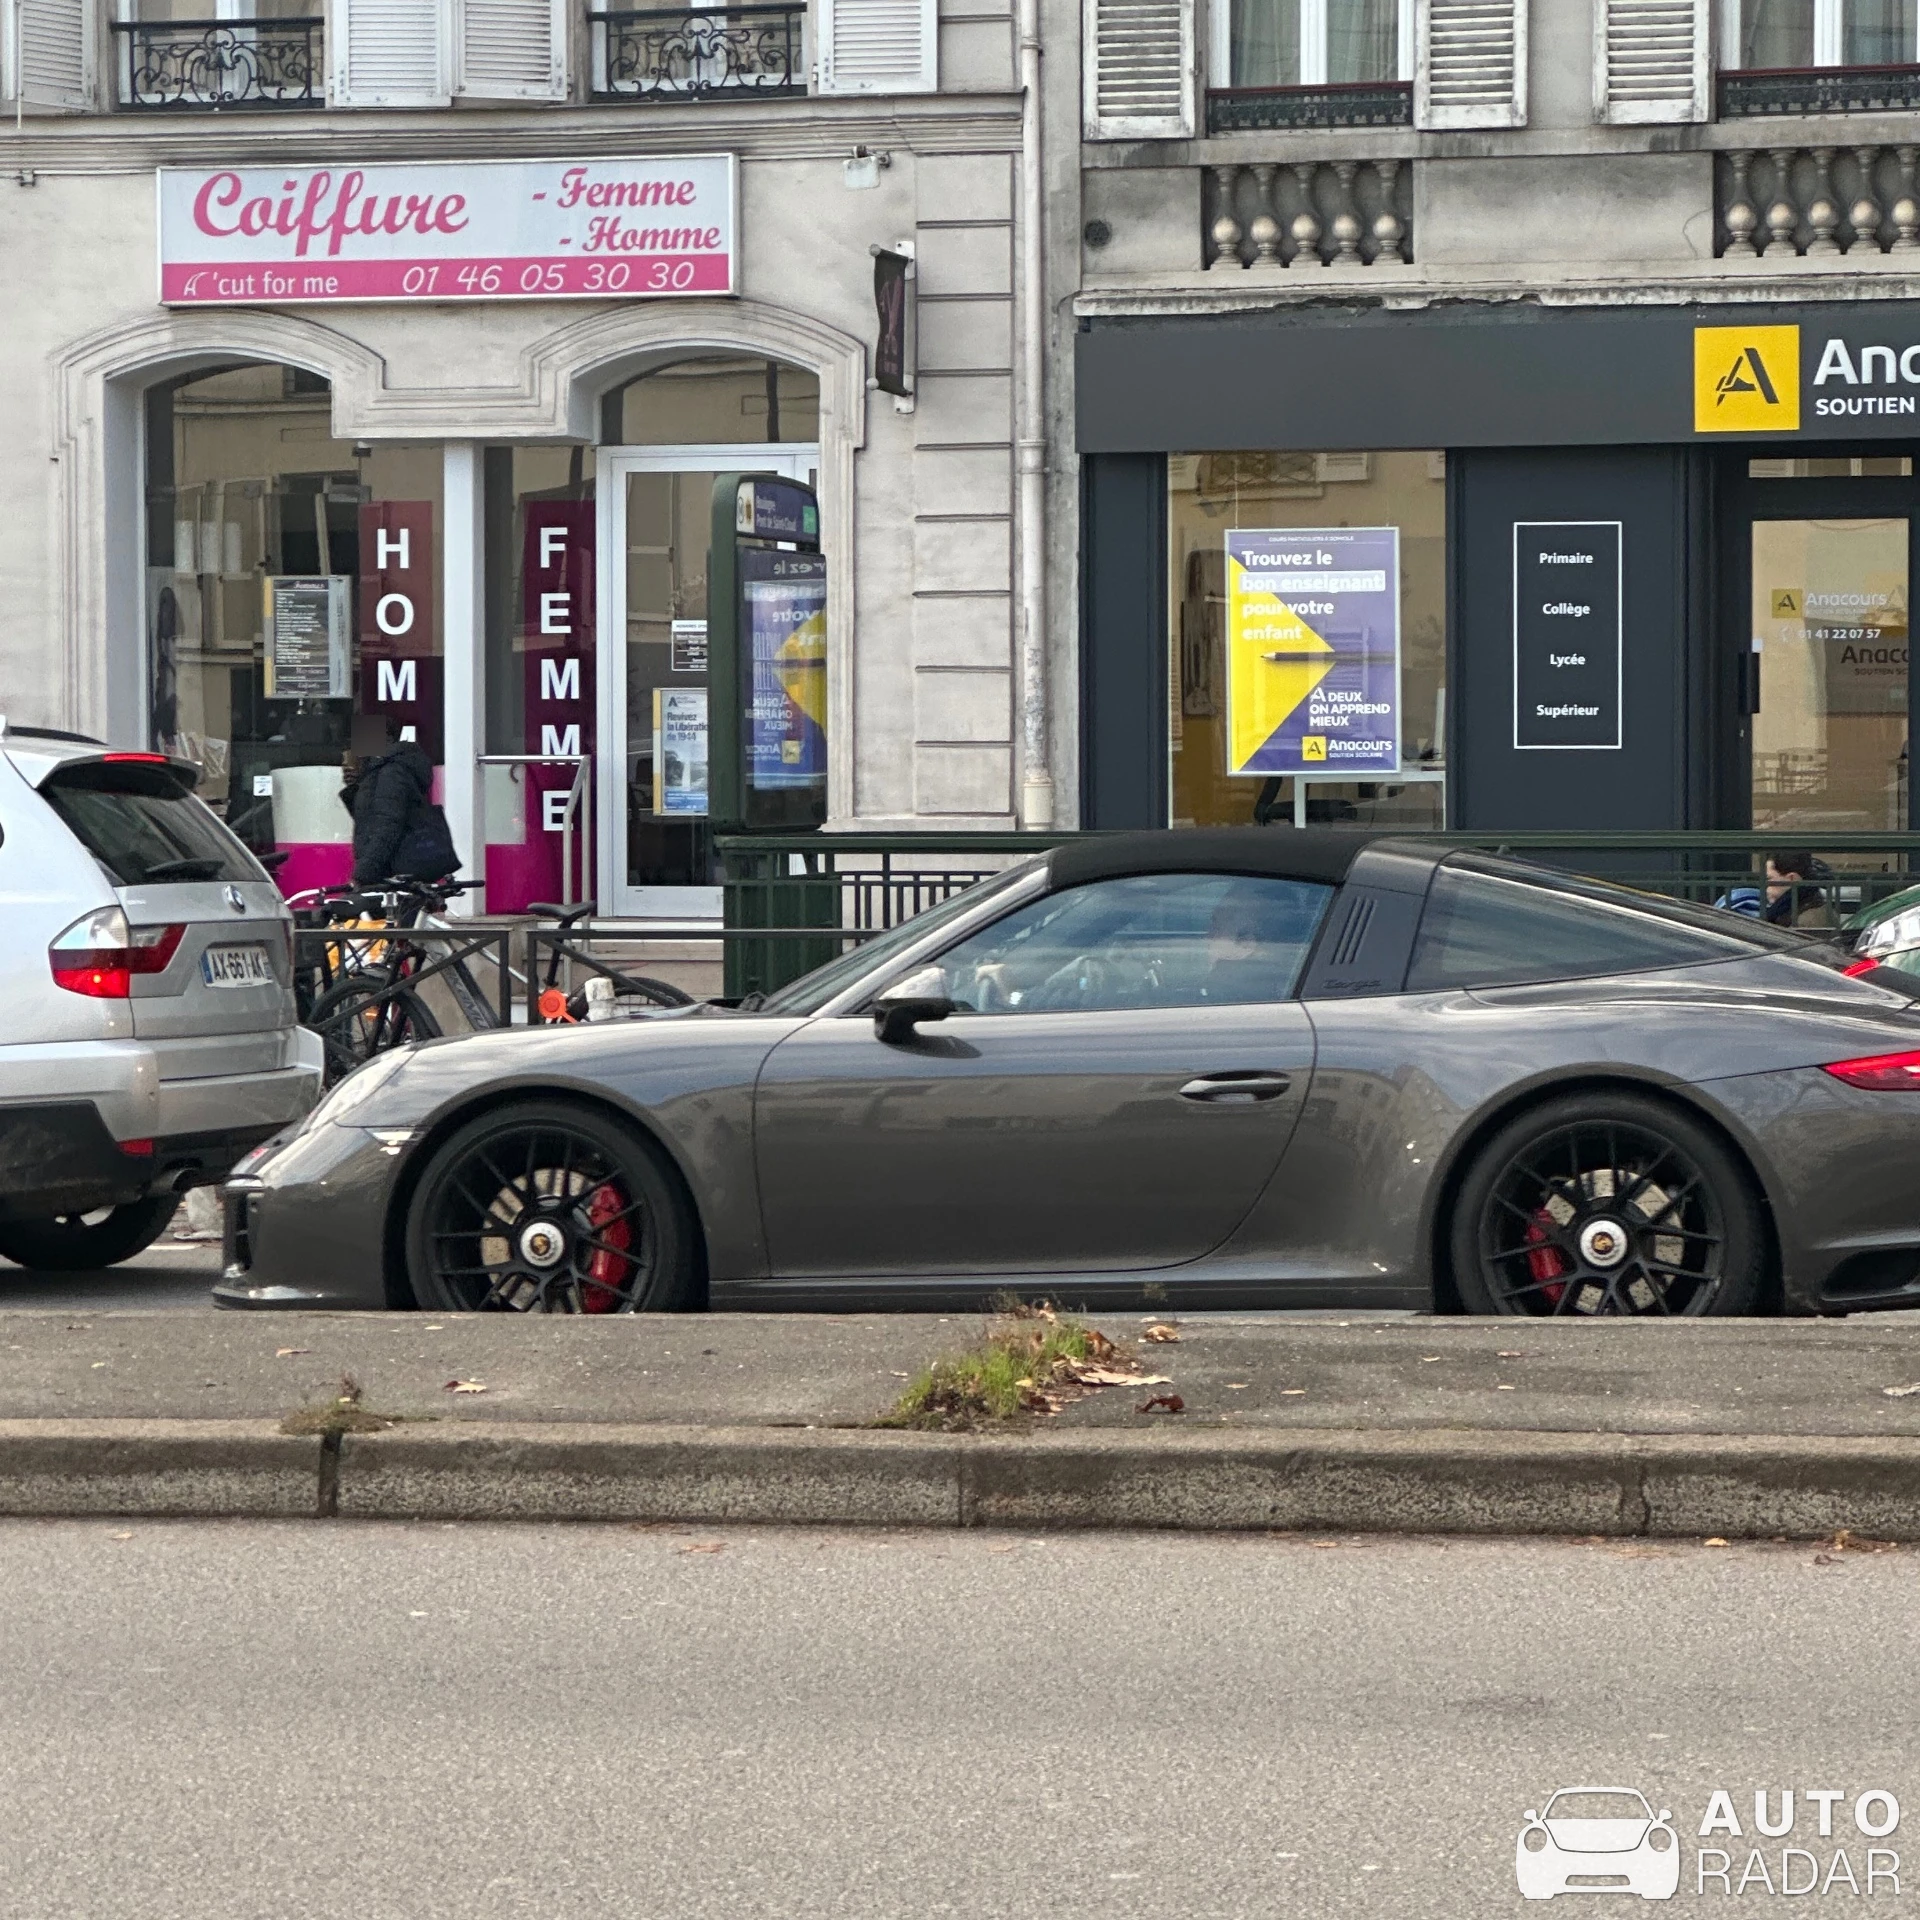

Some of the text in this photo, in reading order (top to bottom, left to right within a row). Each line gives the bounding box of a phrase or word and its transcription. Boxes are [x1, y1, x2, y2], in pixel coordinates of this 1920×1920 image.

[557, 167, 696, 209] Femme
[192, 170, 470, 256] Coiffure
[582, 216, 721, 252] Homme
[262, 270, 297, 295] for
[303, 275, 338, 294] me
[402, 262, 695, 293] 01 46 05 30 30
[1815, 396, 1916, 416] SOUTIEN
[1242, 550, 1332, 565] Trouvez le
[1539, 552, 1593, 564] Primaire
[1242, 574, 1384, 593] bon enseignant
[1806, 592, 1888, 606] Anacours
[1243, 602, 1334, 618] pour votre
[1542, 603, 1591, 617] Collège
[376, 528, 417, 743] HOM
[1243, 625, 1303, 640] enfant
[1815, 629, 1829, 639] 41
[1832, 629, 1847, 639] 22
[1849, 629, 1863, 639] 07
[1866, 629, 1881, 639] 57
[1550, 654, 1586, 668] Lycée
[540, 527, 582, 831] FEMME
[1310, 687, 1362, 703] A DEUX
[1309, 703, 1391, 715] ON APPREND
[1536, 704, 1599, 719] Supérieur
[1309, 715, 1349, 727] MIEUX
[1328, 739, 1393, 752] Anacours
